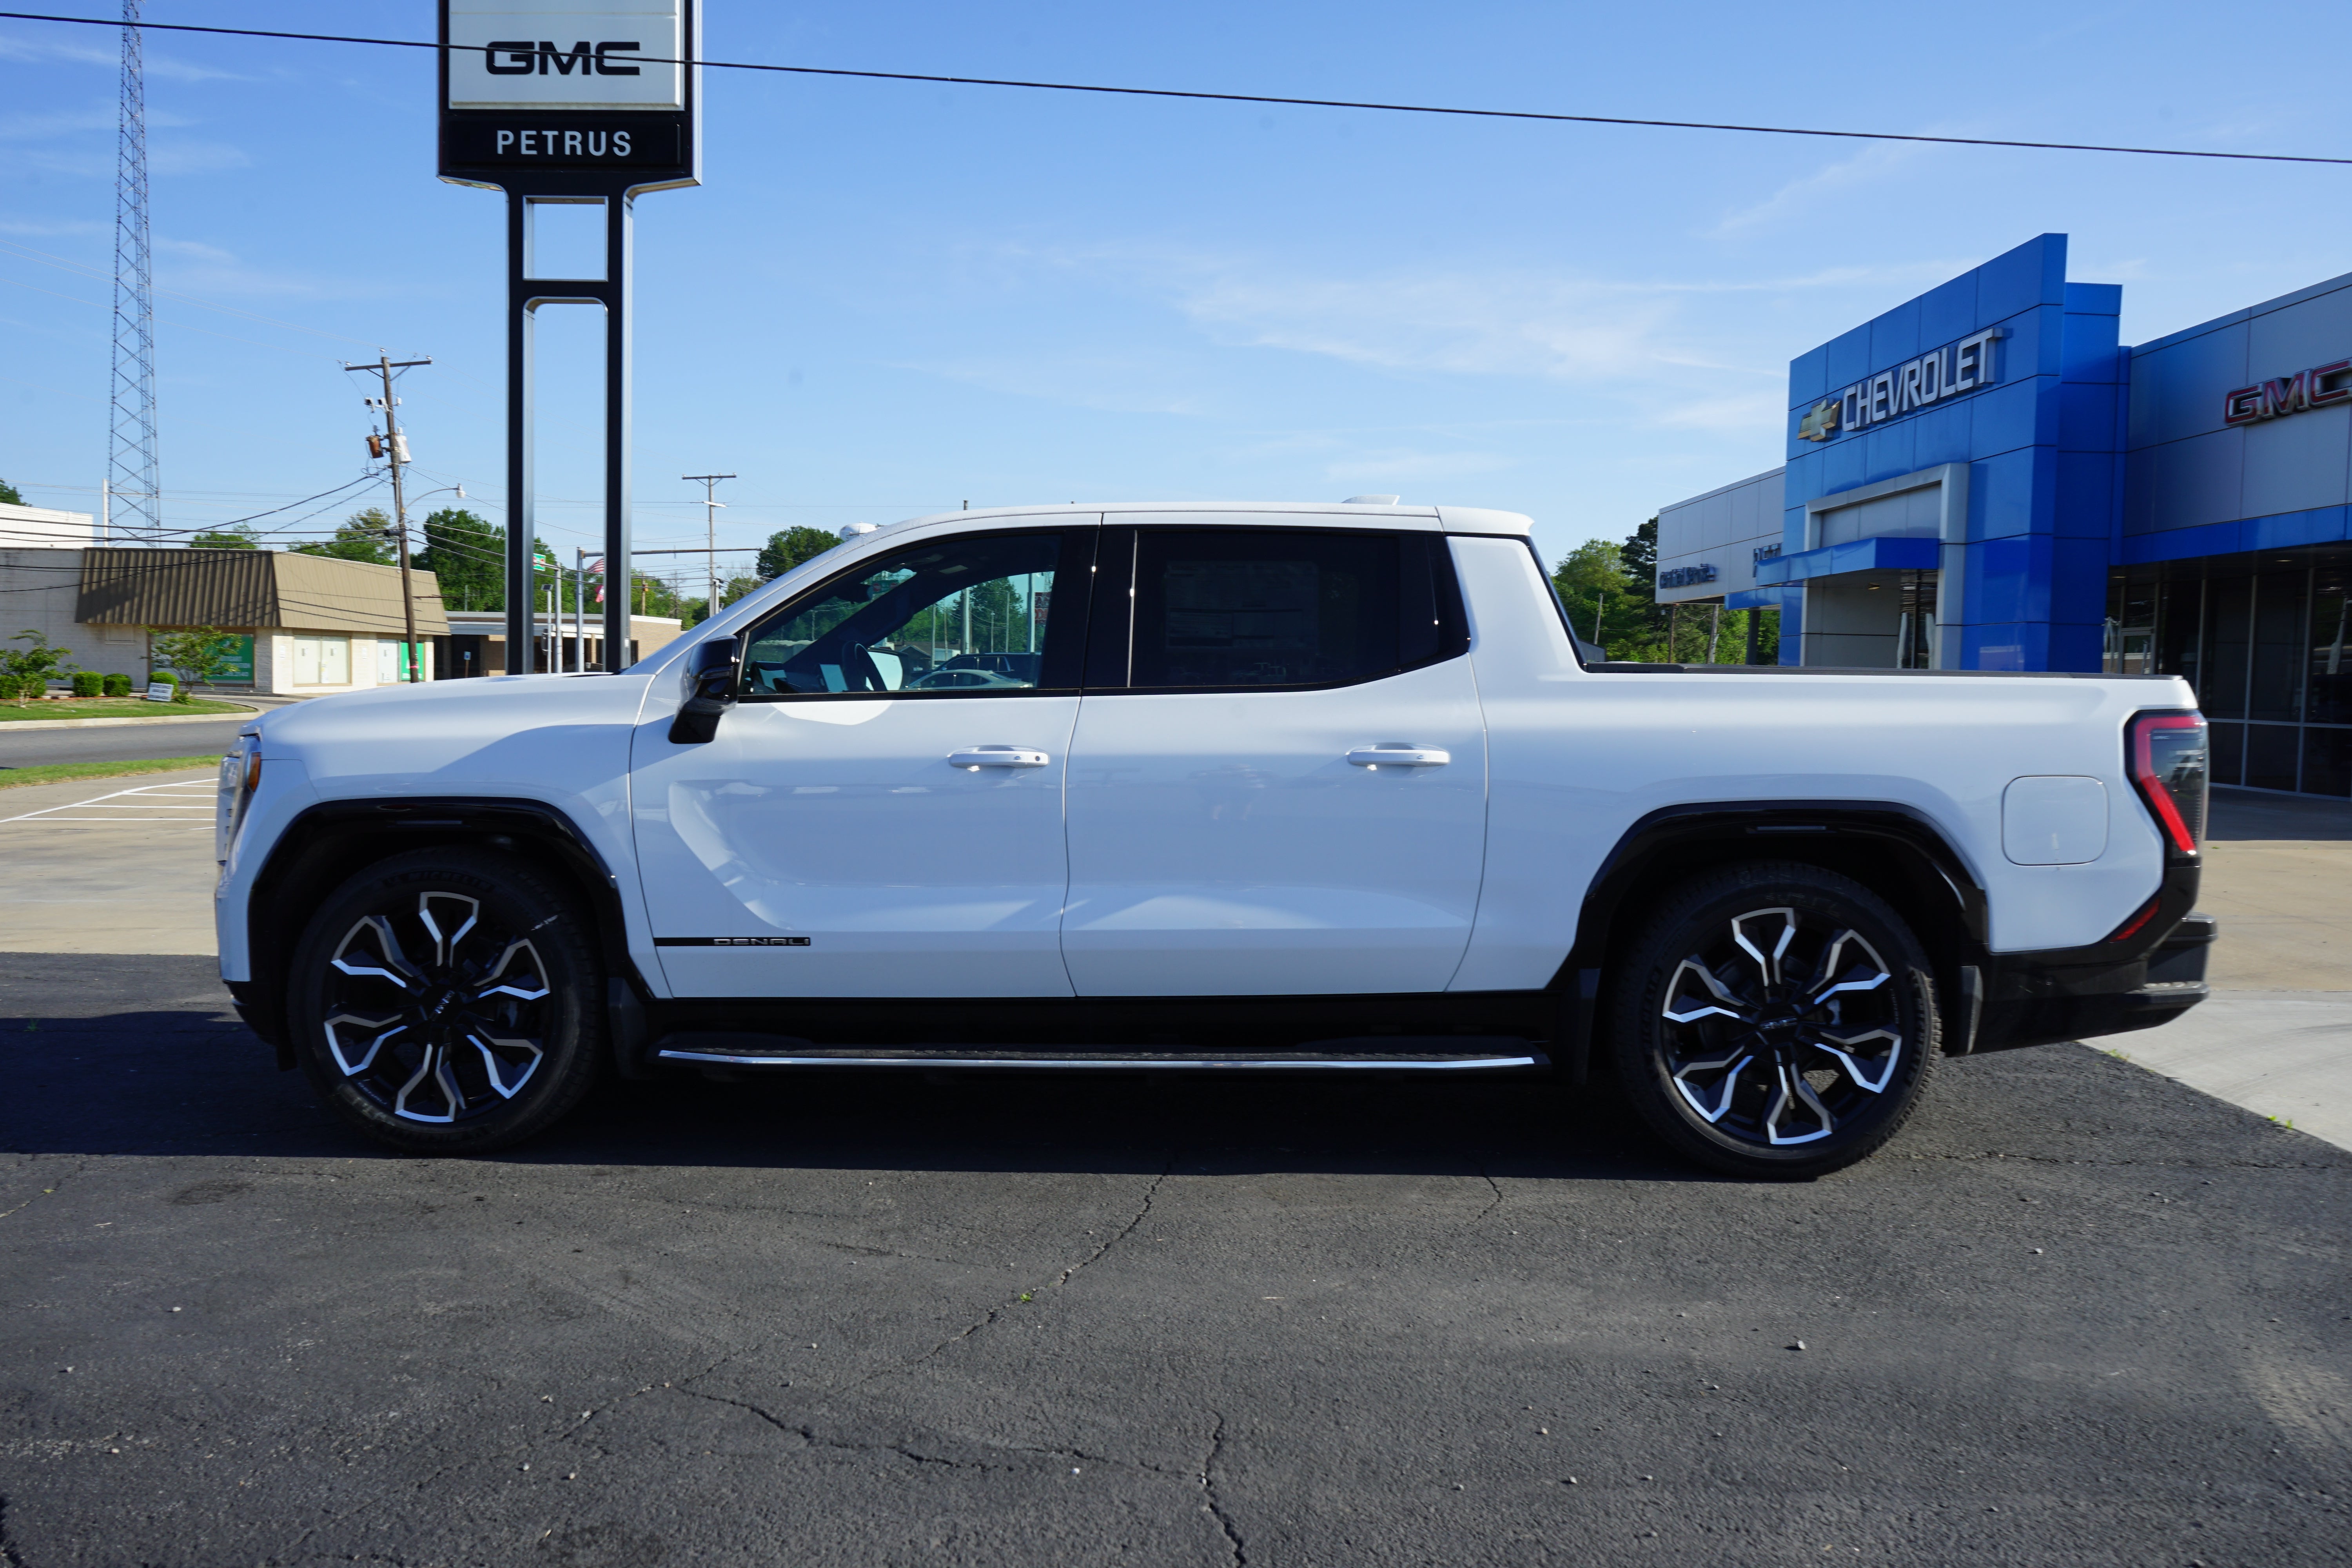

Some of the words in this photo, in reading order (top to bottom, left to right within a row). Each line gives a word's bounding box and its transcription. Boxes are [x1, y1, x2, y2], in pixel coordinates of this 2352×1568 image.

[486, 42, 640, 75] GMC
[497, 131, 631, 156] PETRUS
[1843, 328, 2001, 432] CHEVROLET
[2225, 358, 2352, 426] GMC
[408, 871, 493, 891] MICHELIN
[1759, 1017, 1797, 1031] GMC
